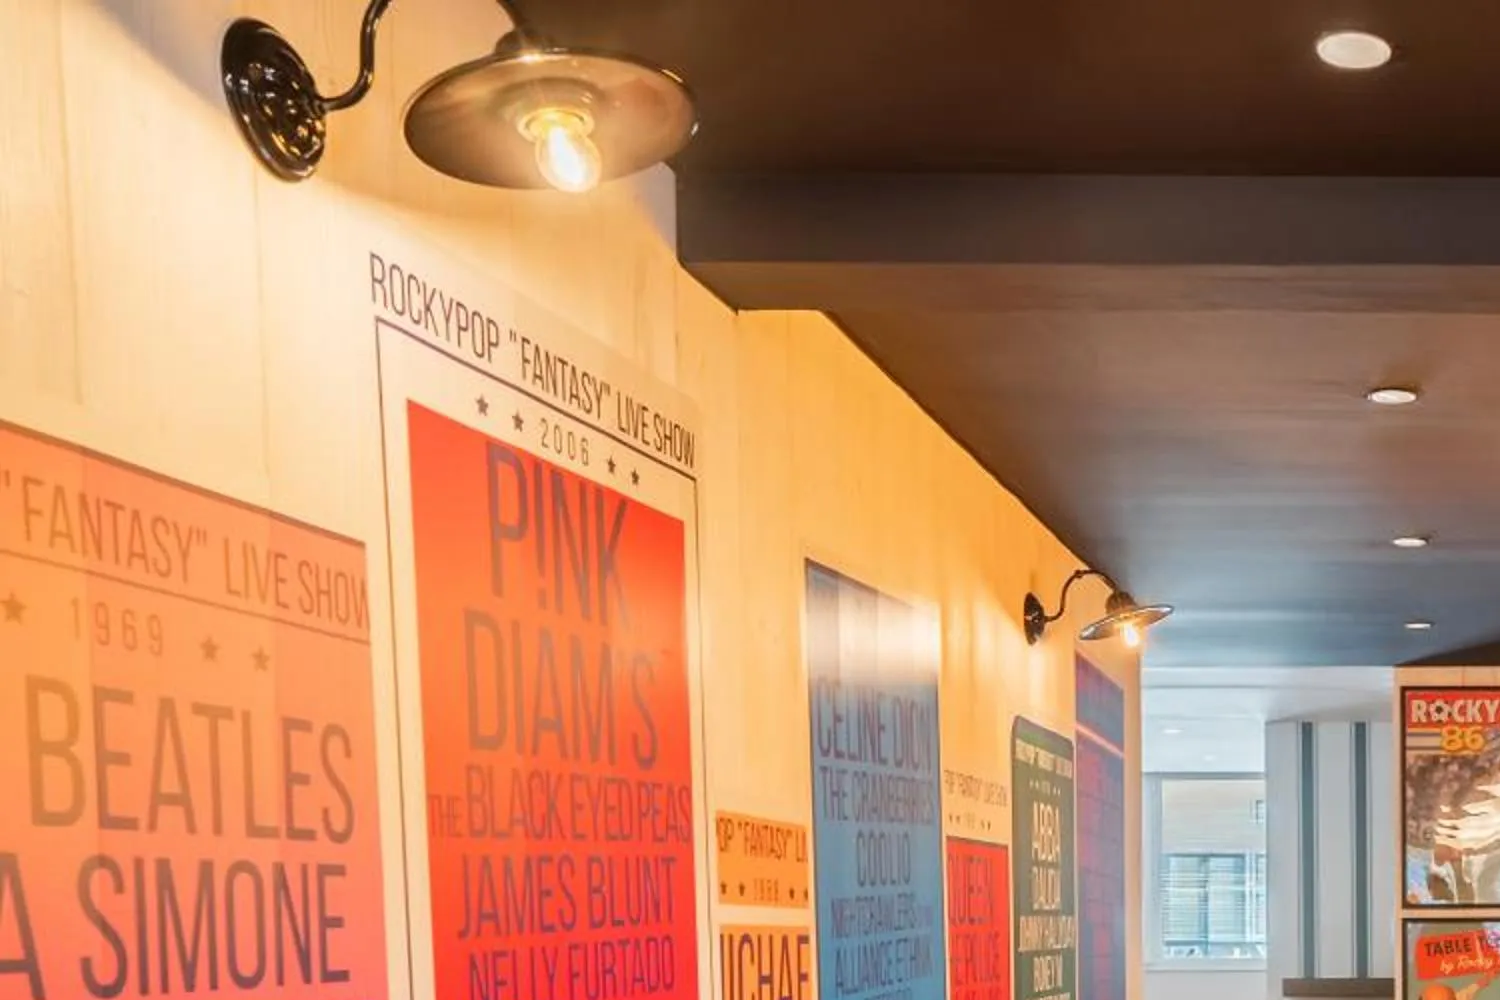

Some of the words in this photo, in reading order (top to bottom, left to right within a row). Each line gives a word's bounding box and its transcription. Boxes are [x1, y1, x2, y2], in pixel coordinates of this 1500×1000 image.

[369, 252, 500, 364] ROCKYPOP
[508, 332, 610, 420] "FANTASY"
[616, 391, 650, 447] LIVE
[653, 413, 695, 468] SHOW
[540, 418, 590, 467] 2006
[223, 535, 288, 611] LIVE
[485, 438, 631, 633] P!NK
[70, 597, 165, 657] 1969
[25, 673, 355, 845] BEATLES
[892, 695, 932, 772] DION
[1440, 726, 1485, 752] 86
[429, 793, 463, 839] THE
[465, 764, 566, 840] BLACK
[570, 772, 633, 842] EYED
[638, 780, 692, 843] PEAS
[819, 765, 848, 821] THE
[857, 828, 911, 888] COOLIO
[77, 853, 351, 999] SIMONE
[459, 855, 577, 940] JAMES
[585, 855, 678, 930] BLUNT
[569, 935, 675, 1000] FURTADO
[1424, 938, 1473, 957] TABLE
